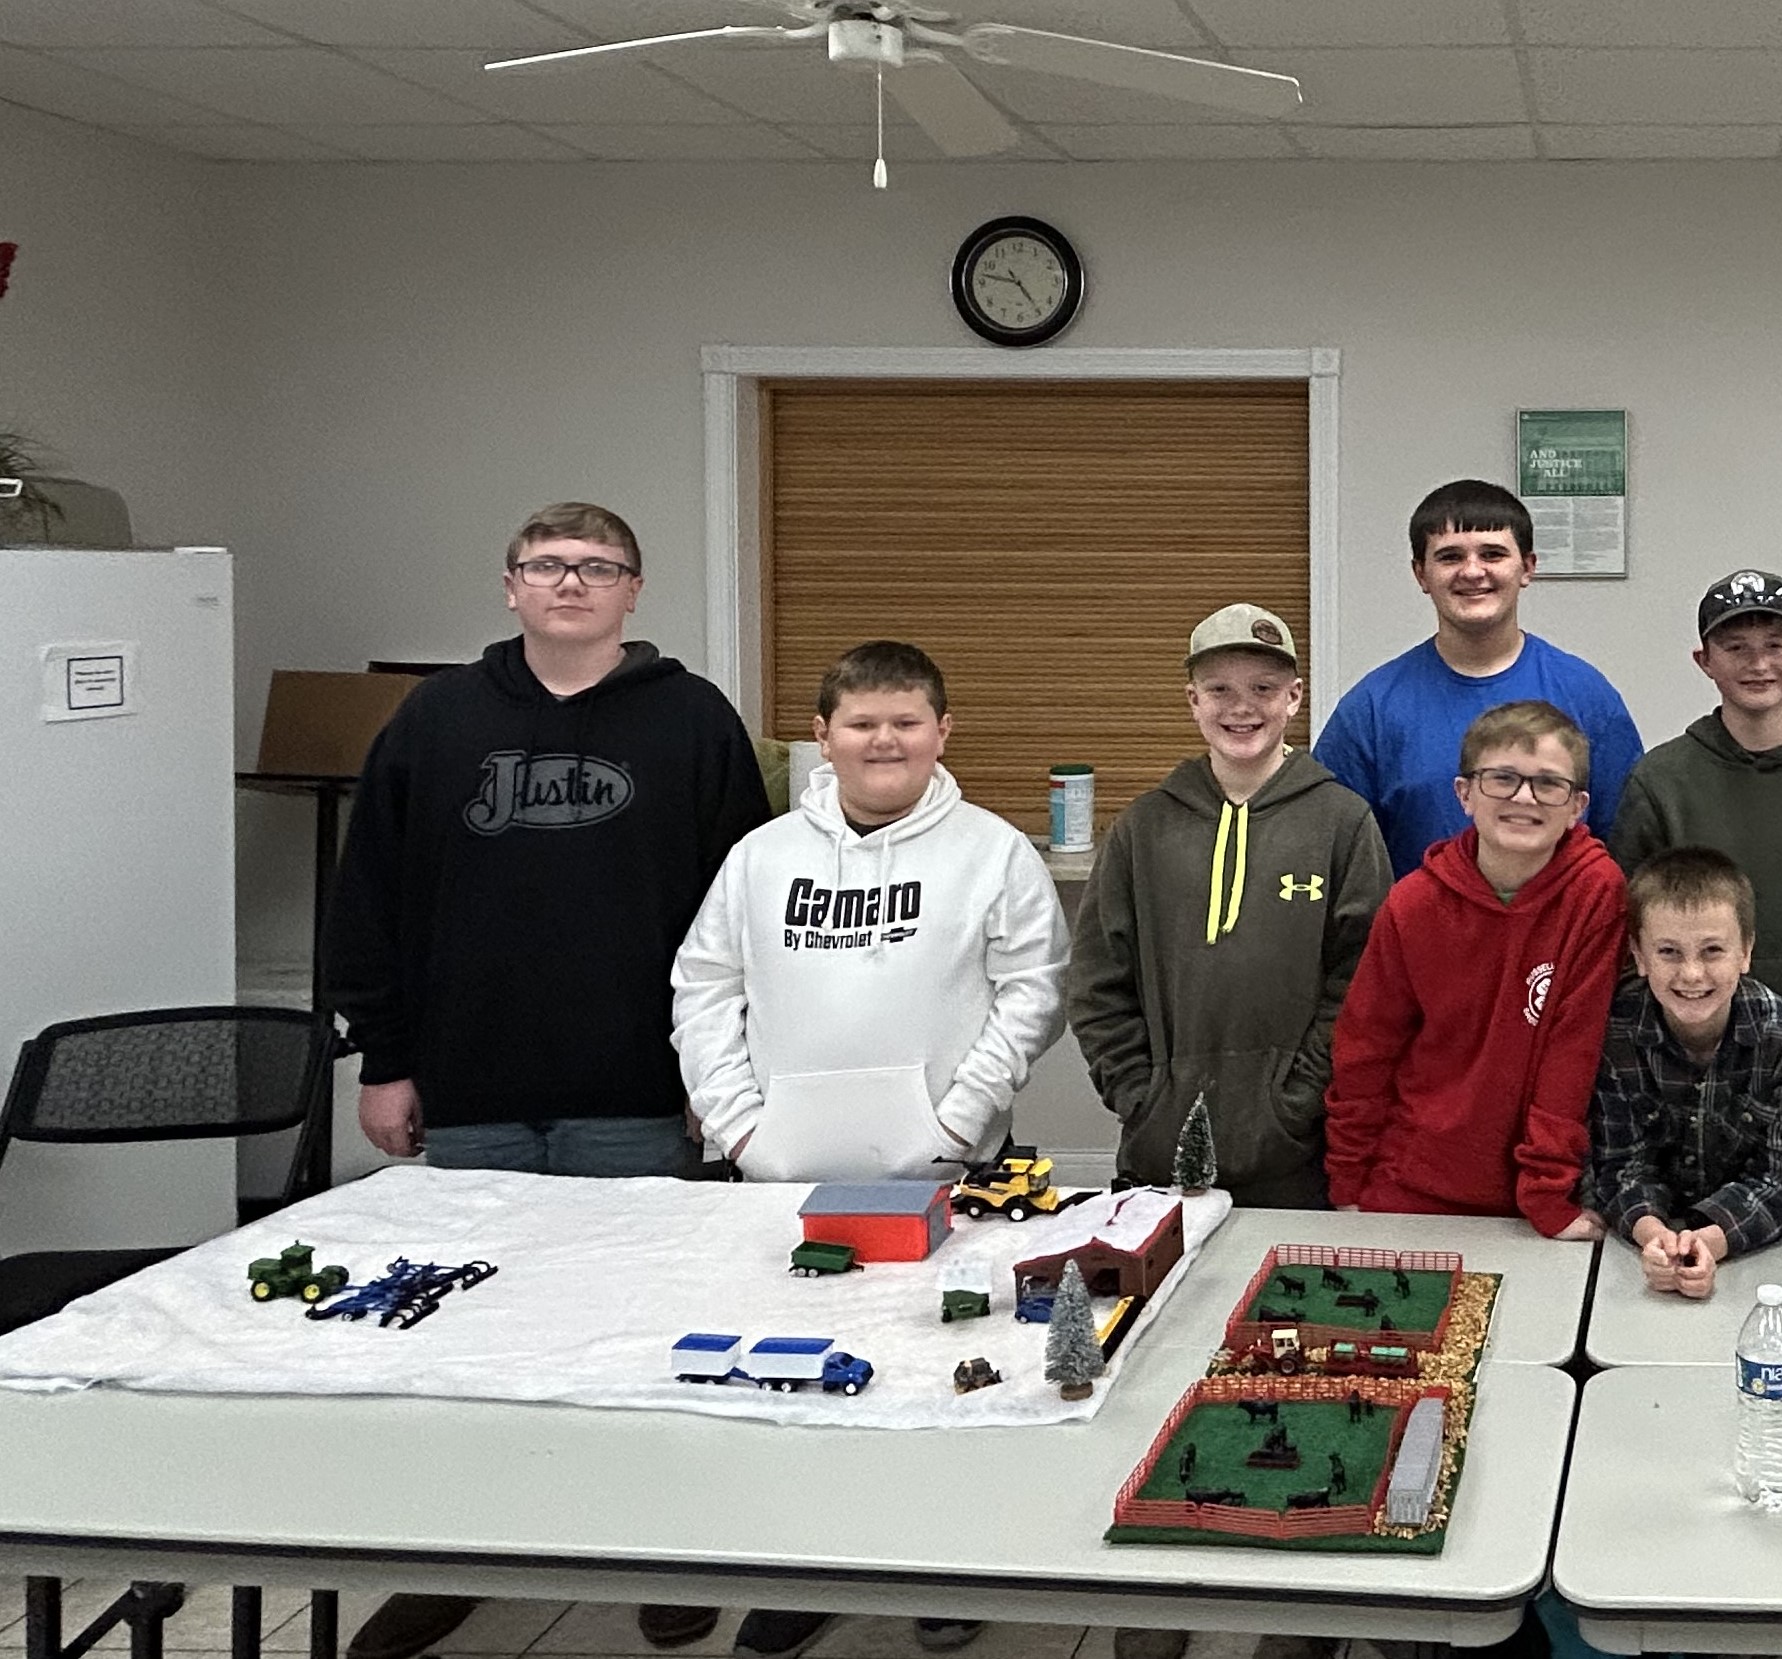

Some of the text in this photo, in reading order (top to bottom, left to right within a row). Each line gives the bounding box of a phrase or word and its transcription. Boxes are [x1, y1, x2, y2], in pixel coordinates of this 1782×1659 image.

[995, 247, 1005, 258] 11
[1012, 242, 1024, 253] 12
[1530, 449, 1557, 459] AND
[1530, 459, 1583, 468] JUSTICE
[1543, 468, 1569, 478] ALL
[464, 750, 616, 836] Justin
[785, 877, 922, 929] Camaro
[784, 929, 873, 951] By Chevrolet
